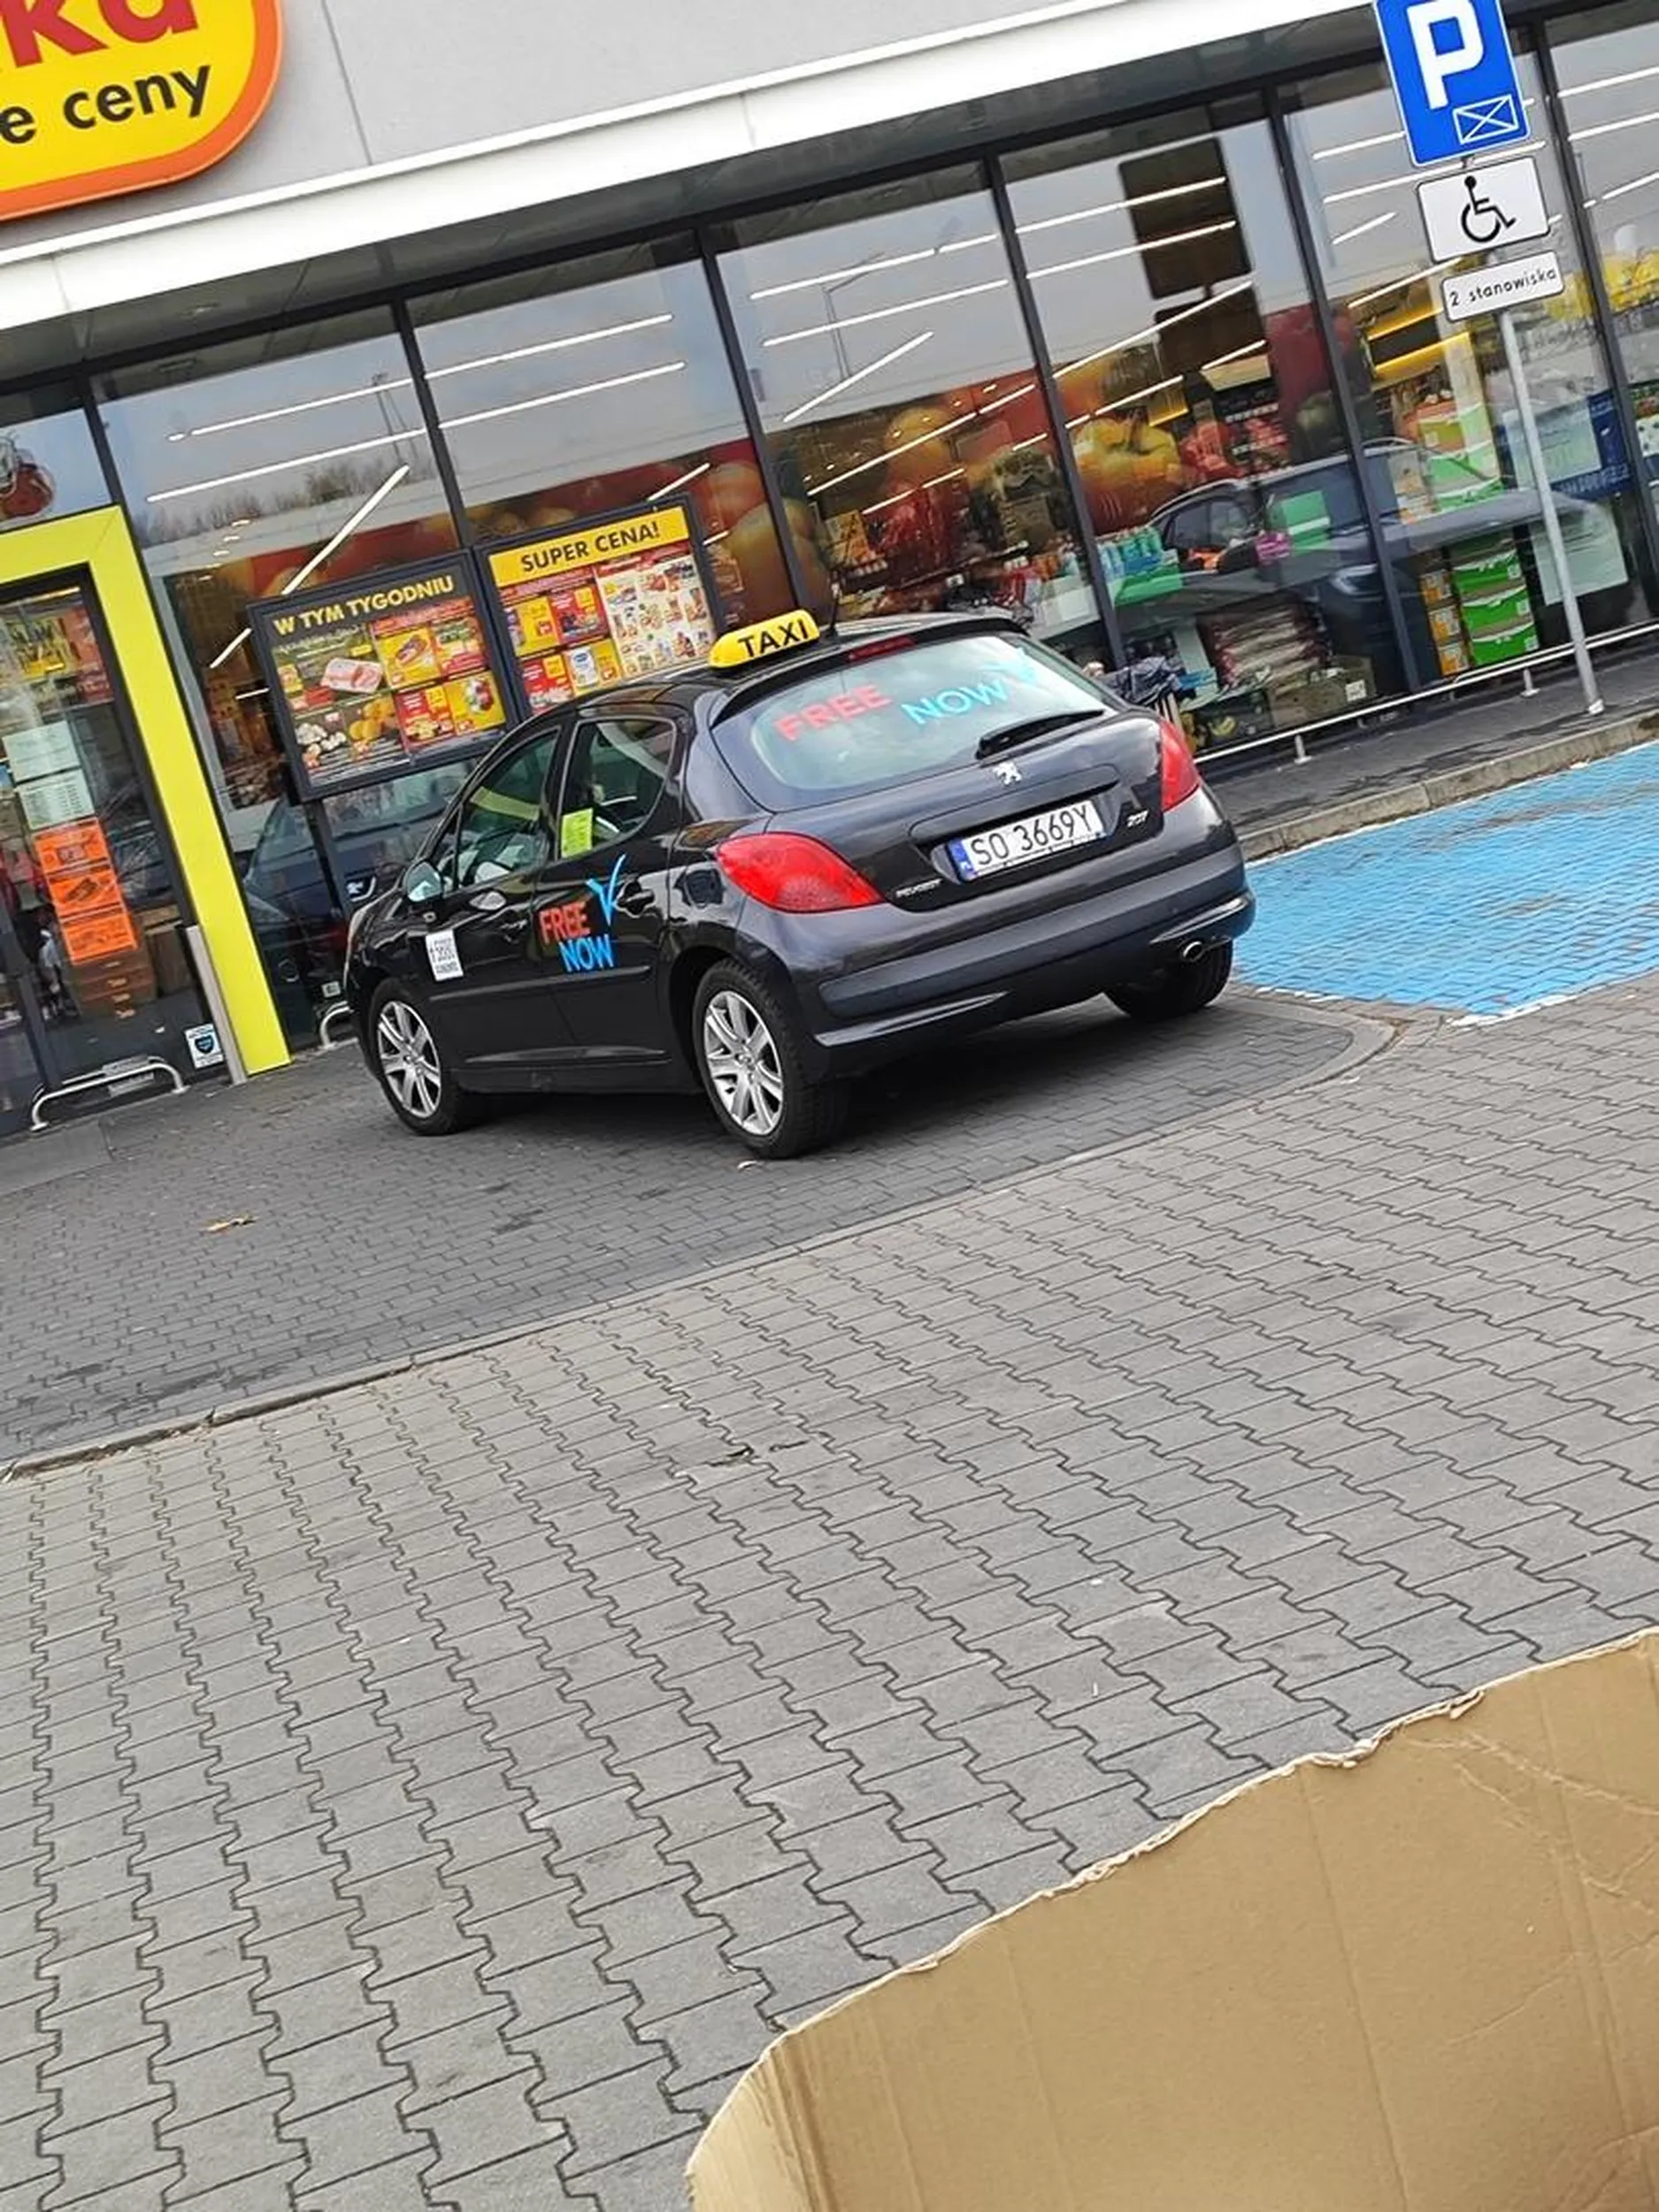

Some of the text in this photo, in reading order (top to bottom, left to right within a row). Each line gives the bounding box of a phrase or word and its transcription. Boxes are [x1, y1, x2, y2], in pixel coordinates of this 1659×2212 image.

[1406, 0, 1484, 110] P
[63, 65, 211, 129] ceny
[1449, 266, 1557, 308] 2 stanowiska
[520, 542, 589, 573] SUPER
[595, 522, 661, 553] CENA!
[273, 616, 295, 636] W
[297, 604, 345, 629] TYM
[346, 575, 455, 614] TYGODNIU
[737, 618, 810, 658] TAXI
[772, 678, 1010, 741] FREE NOW
[972, 804, 1094, 866] SO 3669Y
[538, 900, 591, 945] FREE
[558, 933, 615, 973] NOW
